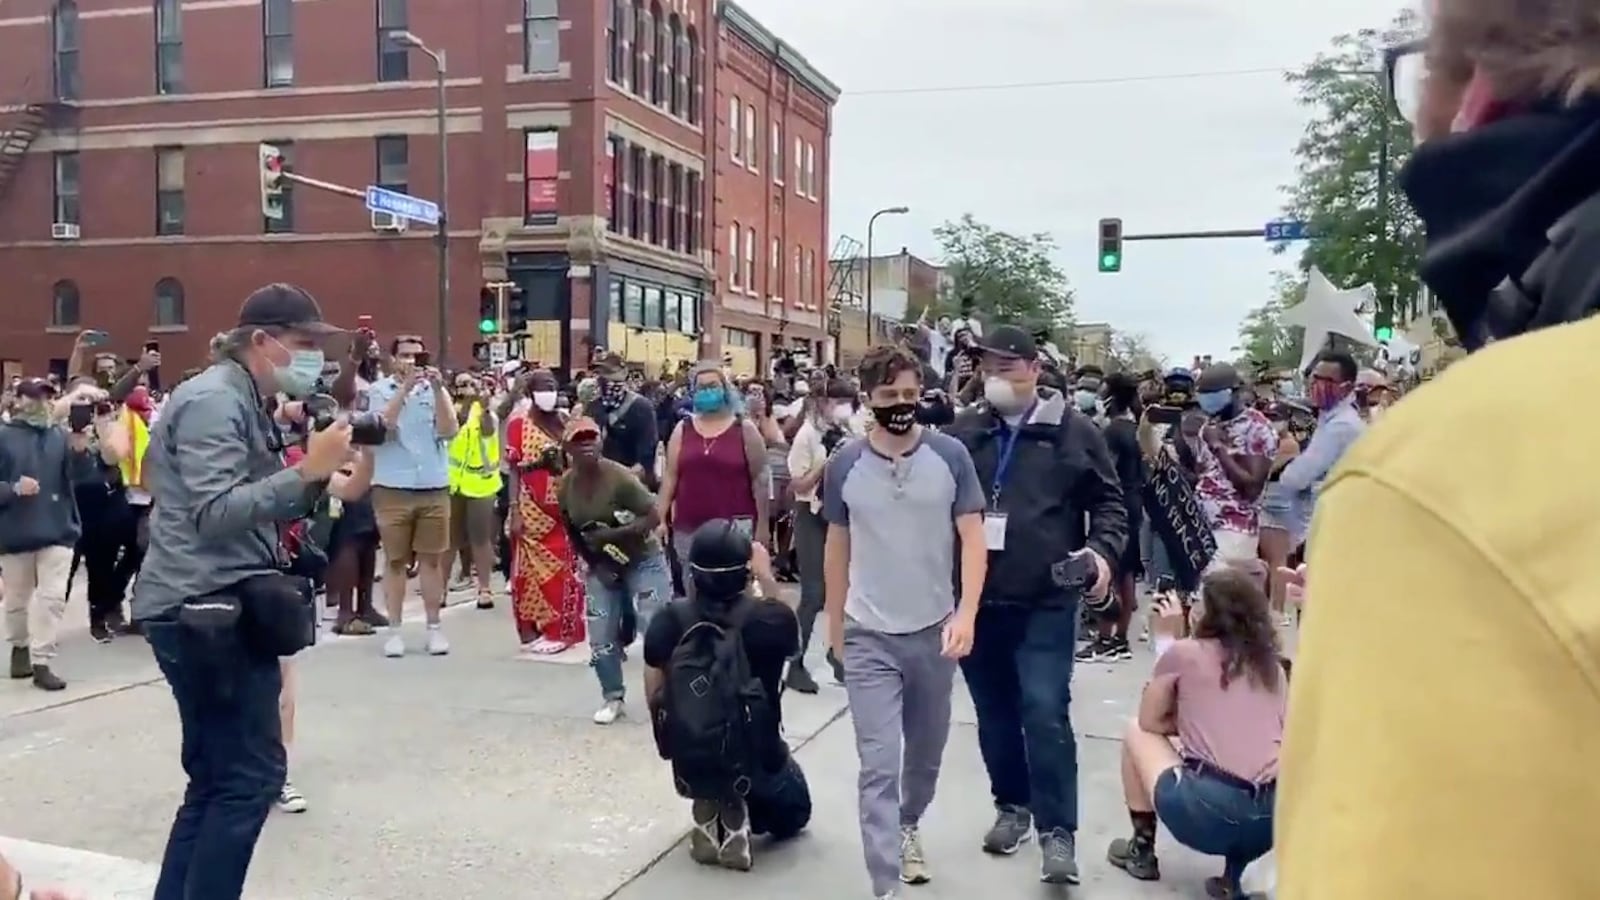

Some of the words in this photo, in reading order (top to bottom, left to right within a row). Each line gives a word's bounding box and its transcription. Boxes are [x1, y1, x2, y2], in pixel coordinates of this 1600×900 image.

[1271, 225, 1291, 238] SE
[1157, 450, 1179, 484] NO
[1151, 474, 1169, 507] NO
[1167, 505, 1201, 570] PEACE
